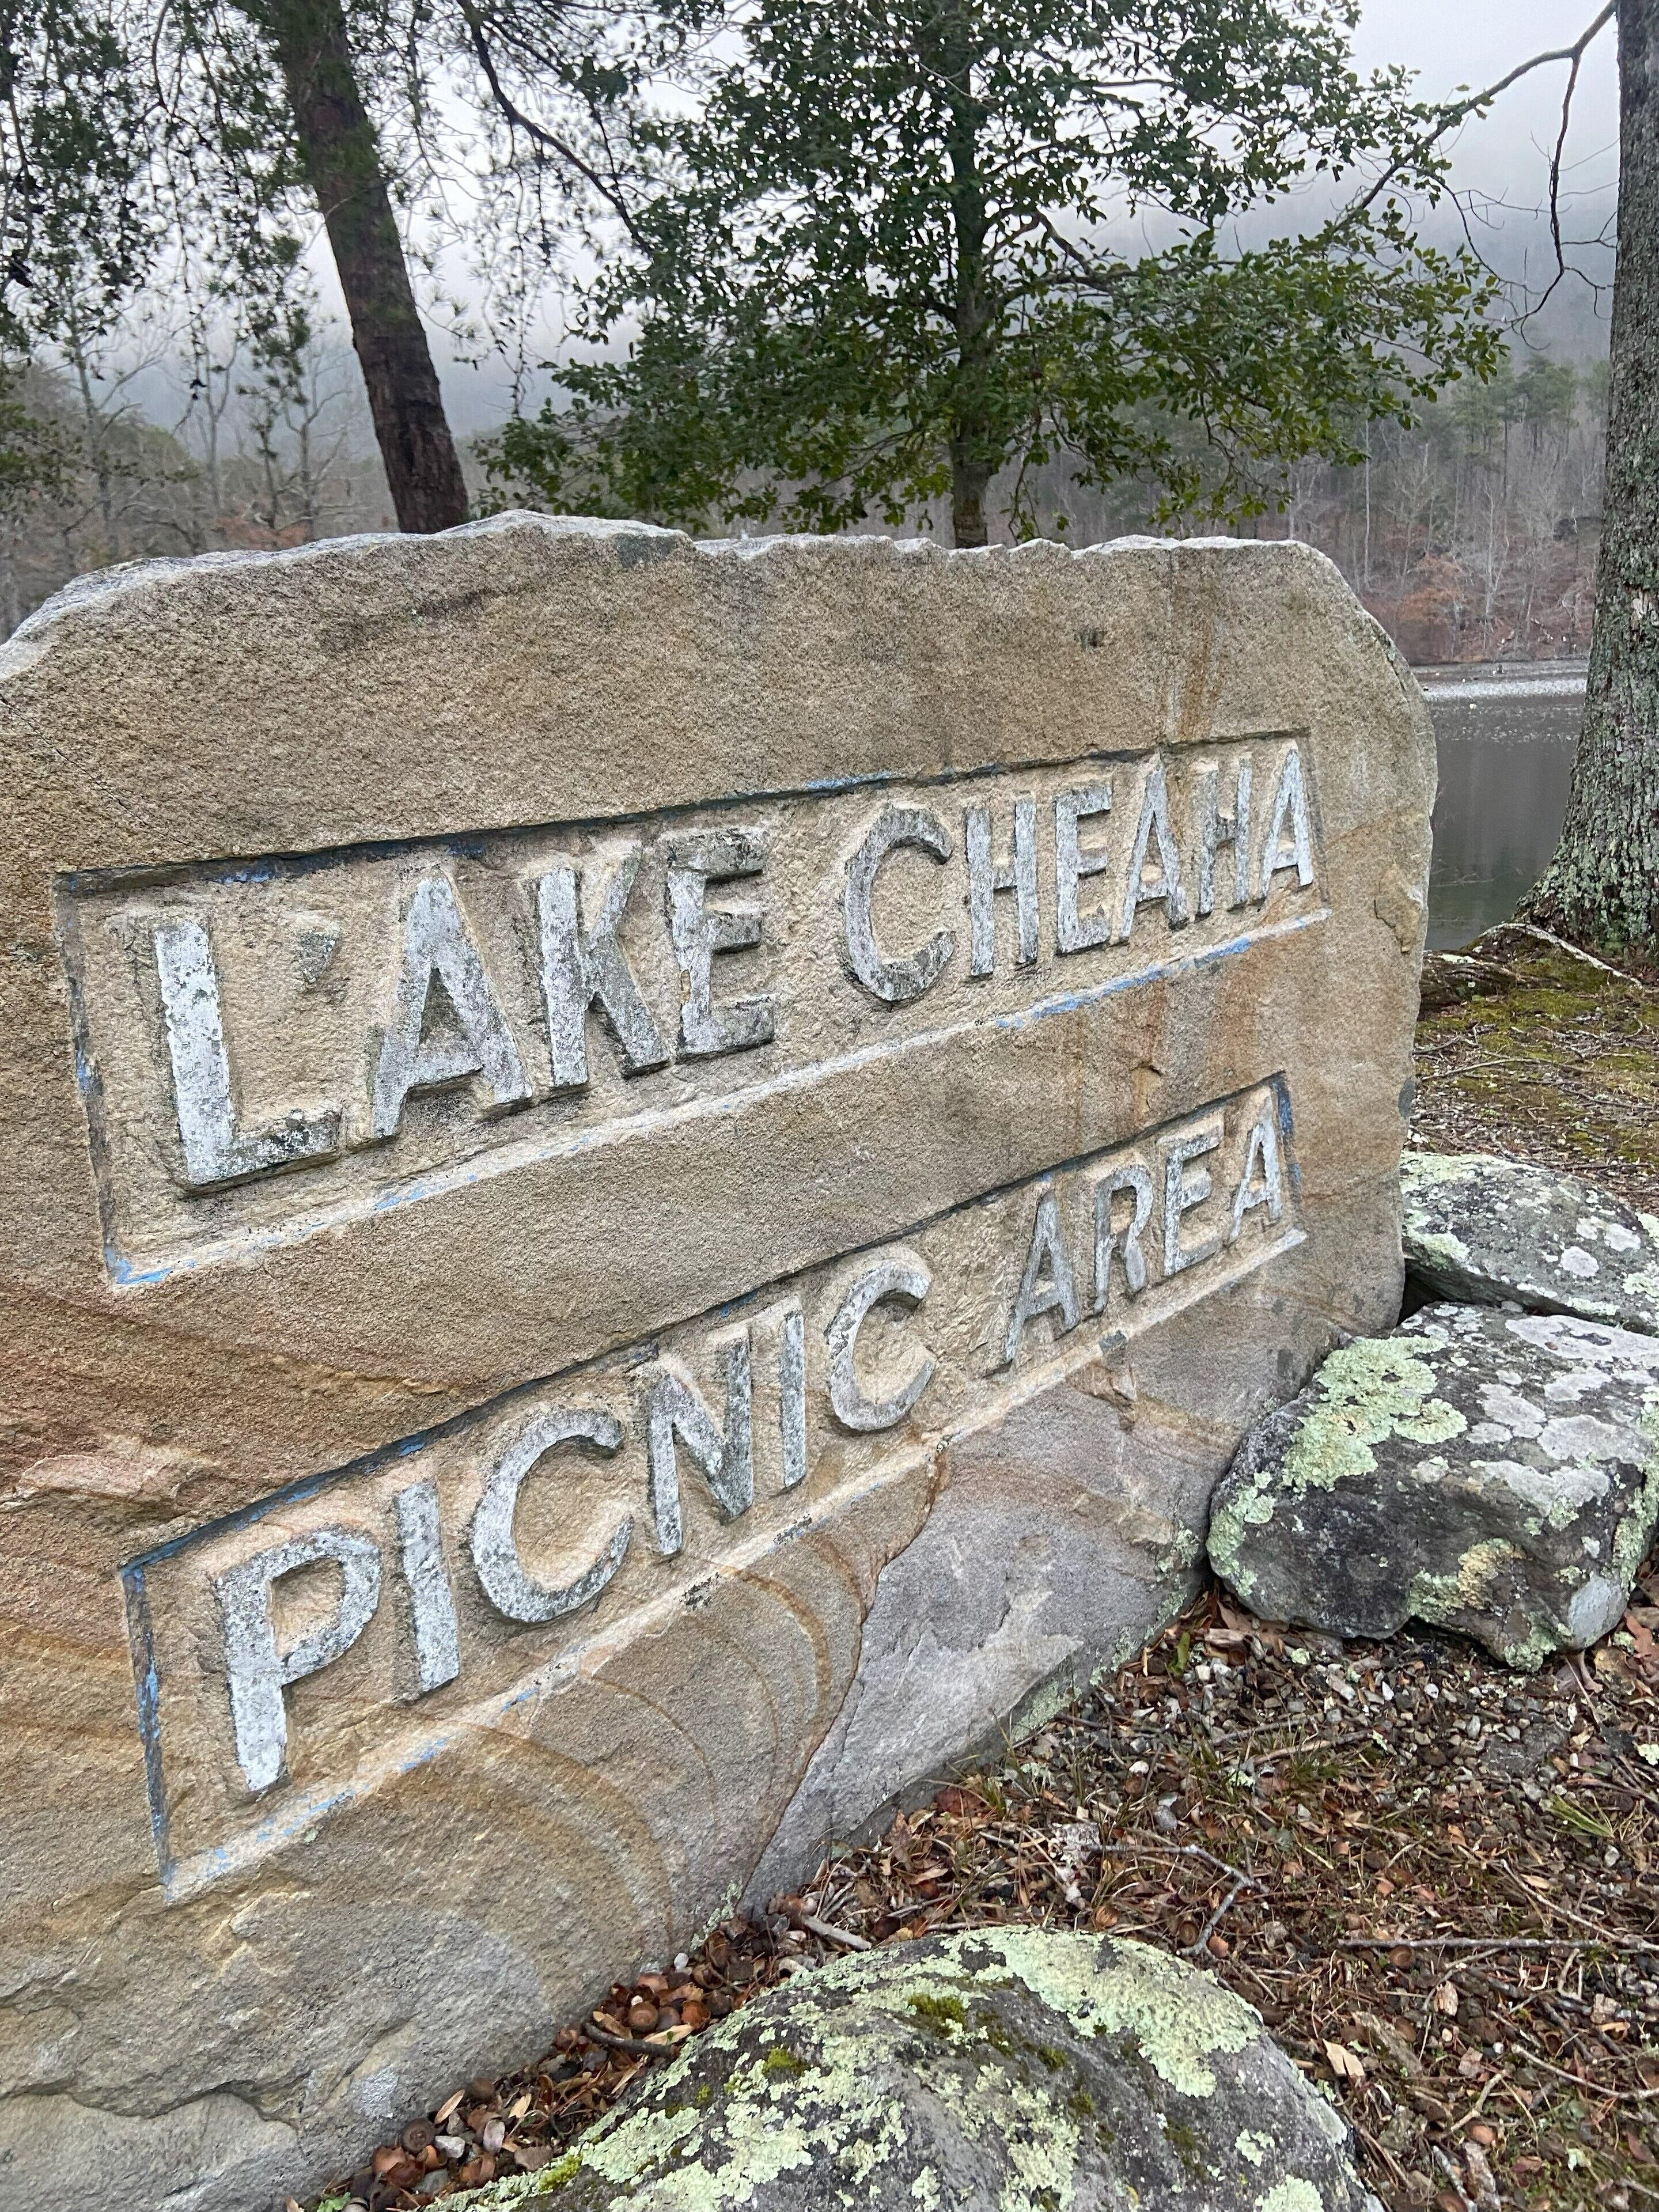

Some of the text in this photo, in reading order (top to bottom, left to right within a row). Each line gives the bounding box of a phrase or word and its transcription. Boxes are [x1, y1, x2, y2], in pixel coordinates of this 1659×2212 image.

[154, 743, 1314, 1187] LAKE CHEAHA
[217, 1088, 1282, 1791] PICNIC AREA
